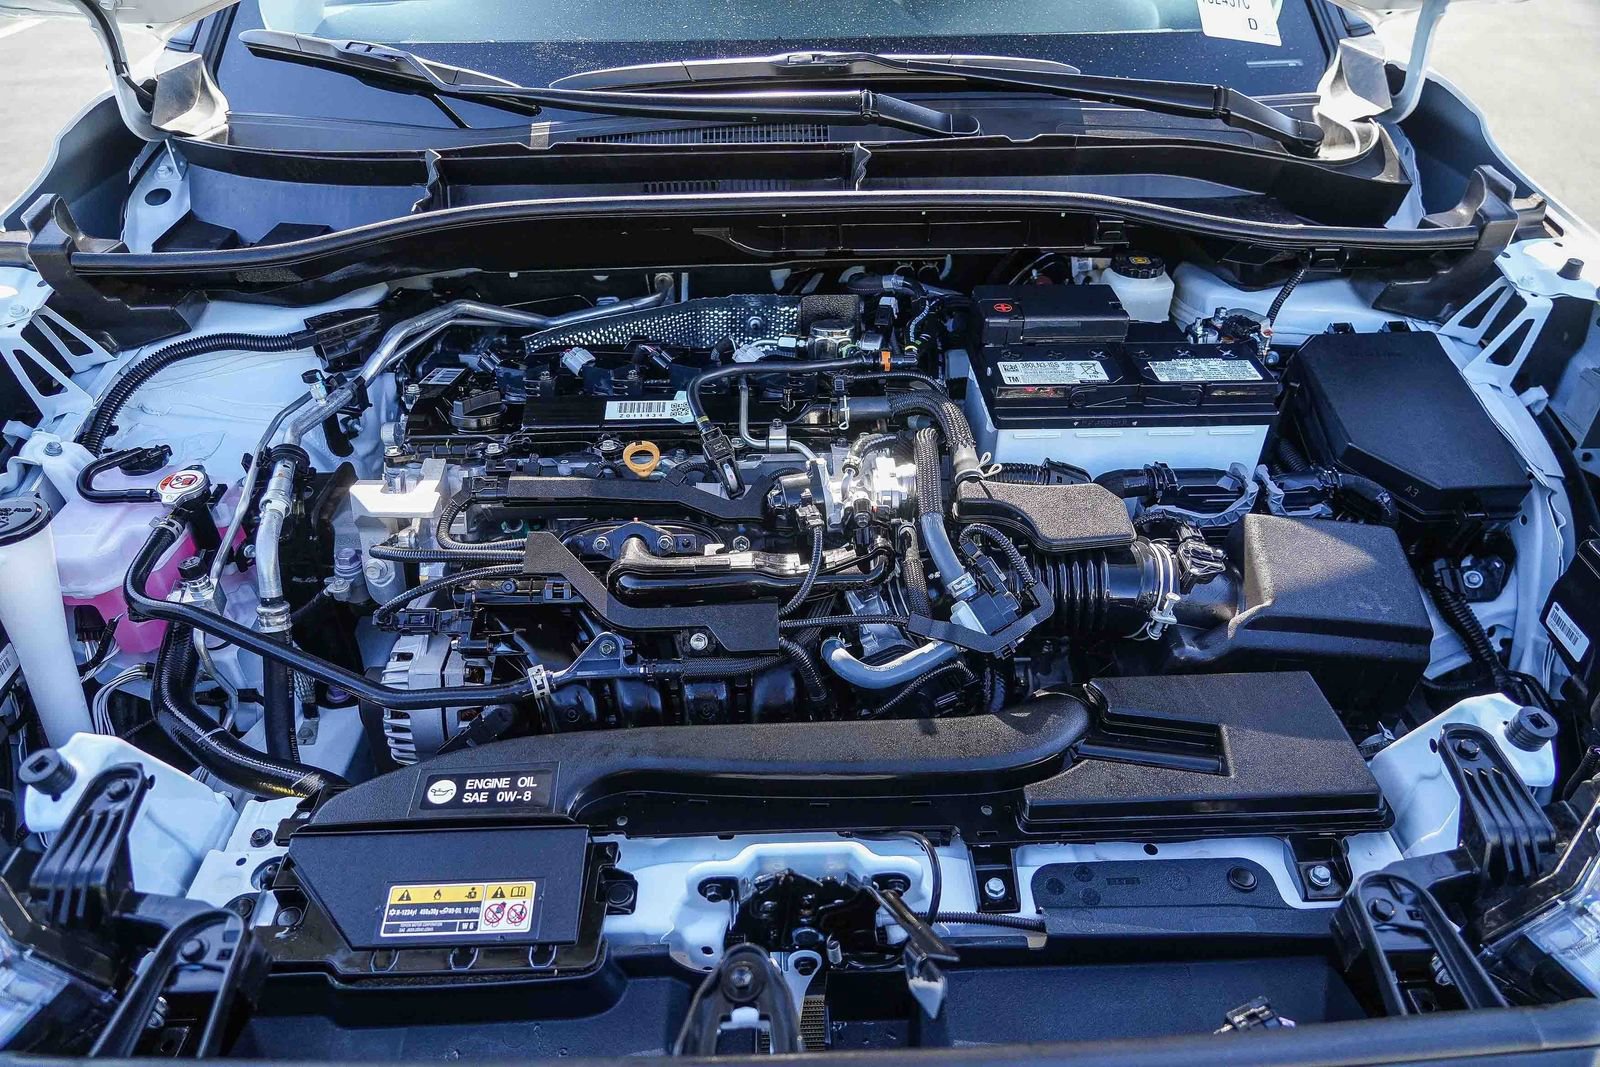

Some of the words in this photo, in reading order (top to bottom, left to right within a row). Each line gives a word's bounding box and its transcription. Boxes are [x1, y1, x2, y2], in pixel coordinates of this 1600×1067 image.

[1247, 18, 1258, 30] D
[465, 777, 511, 790] ENGINE
[517, 776, 537, 788] OIL
[462, 792, 488, 803] SAE
[496, 790, 532, 802] 0W-8
